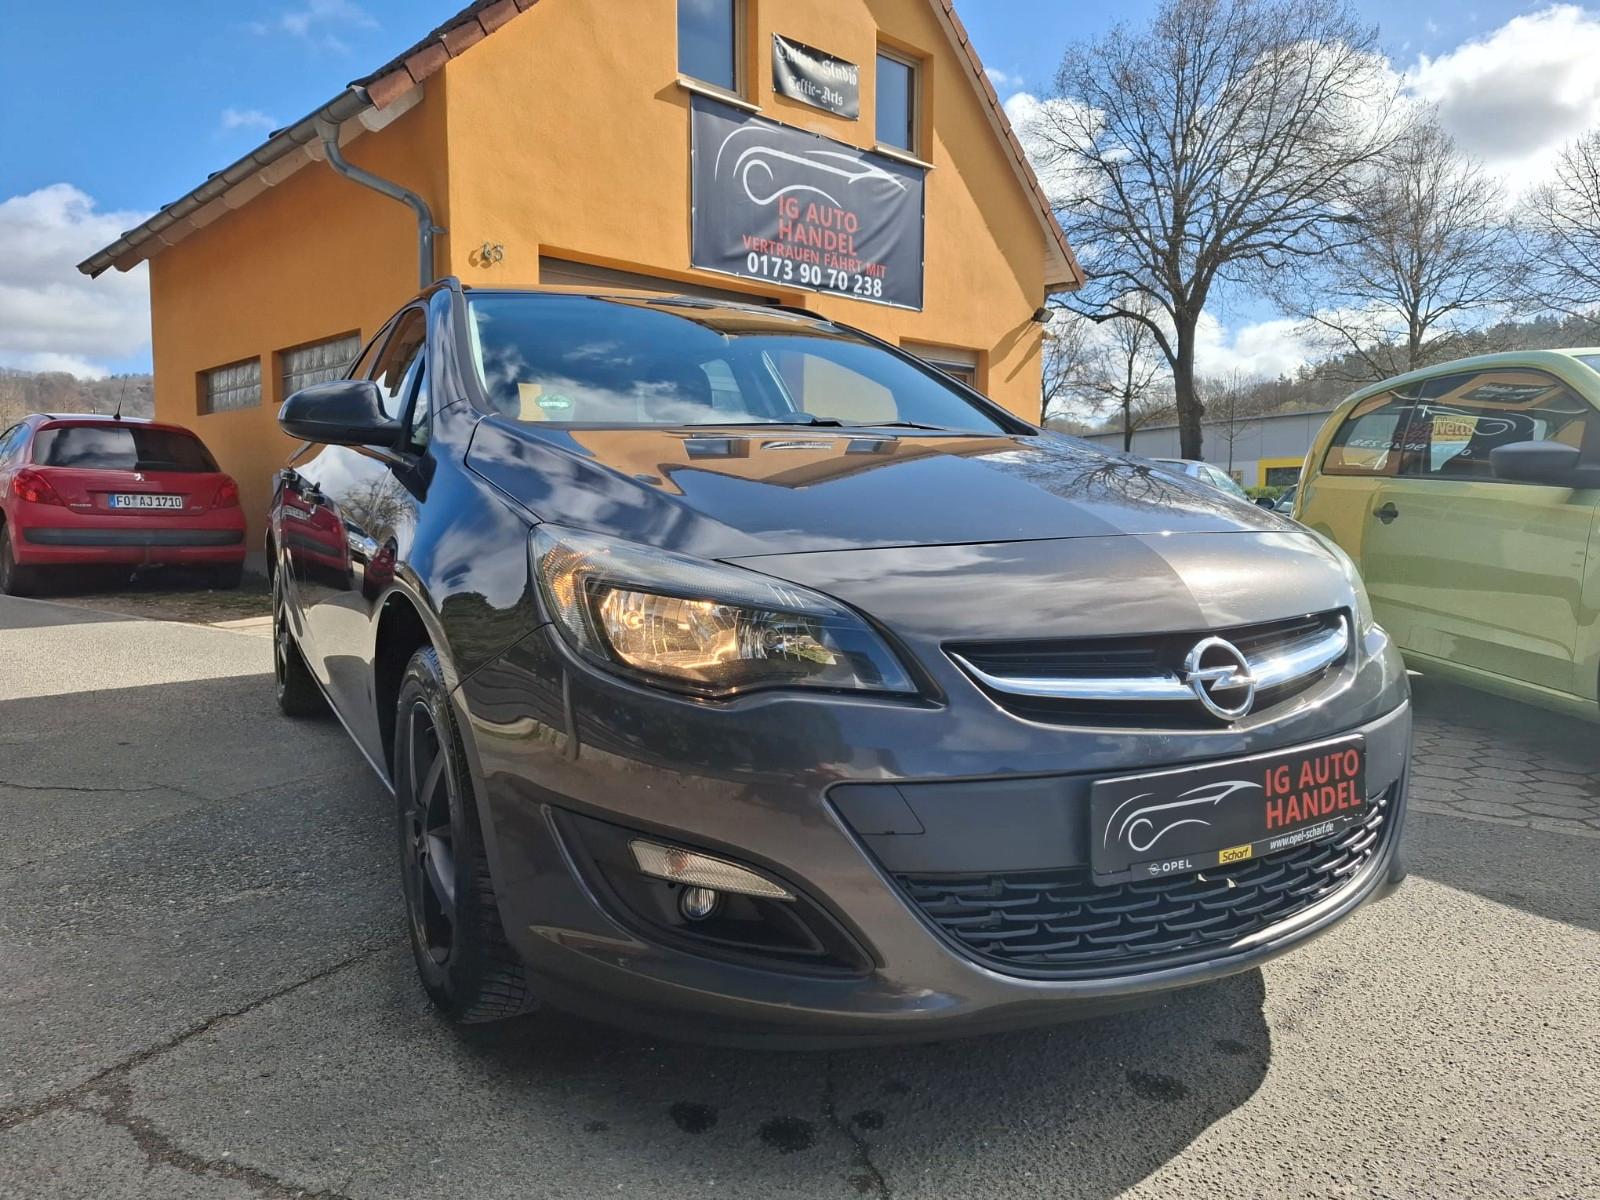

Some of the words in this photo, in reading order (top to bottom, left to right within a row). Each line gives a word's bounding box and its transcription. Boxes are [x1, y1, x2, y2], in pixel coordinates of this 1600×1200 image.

[778, 195, 800, 219] IG
[806, 203, 858, 233] AUTO
[742, 234, 819, 264] VERTRAUEN
[824, 252, 863, 273] FÄHRT
[865, 263, 887, 278] MIT
[778, 218, 857, 256] HANDEL
[747, 252, 793, 280] 0173
[800, 263, 822, 286] 90
[827, 269, 848, 290] 70
[853, 275, 882, 297] 238
[1435, 415, 1474, 436] Netto
[116, 495, 131, 506] FO
[139, 496, 153, 507] AJ
[156, 497, 181, 507] 1710
[1265, 765, 1290, 797] IG
[1299, 749, 1359, 789] AUTO
[1266, 780, 1360, 829] HANDEL
[1222, 847, 1249, 862] Scharf
[1270, 822, 1334, 850] www.opel-scharf.de
[1162, 859, 1192, 872] OPEL
